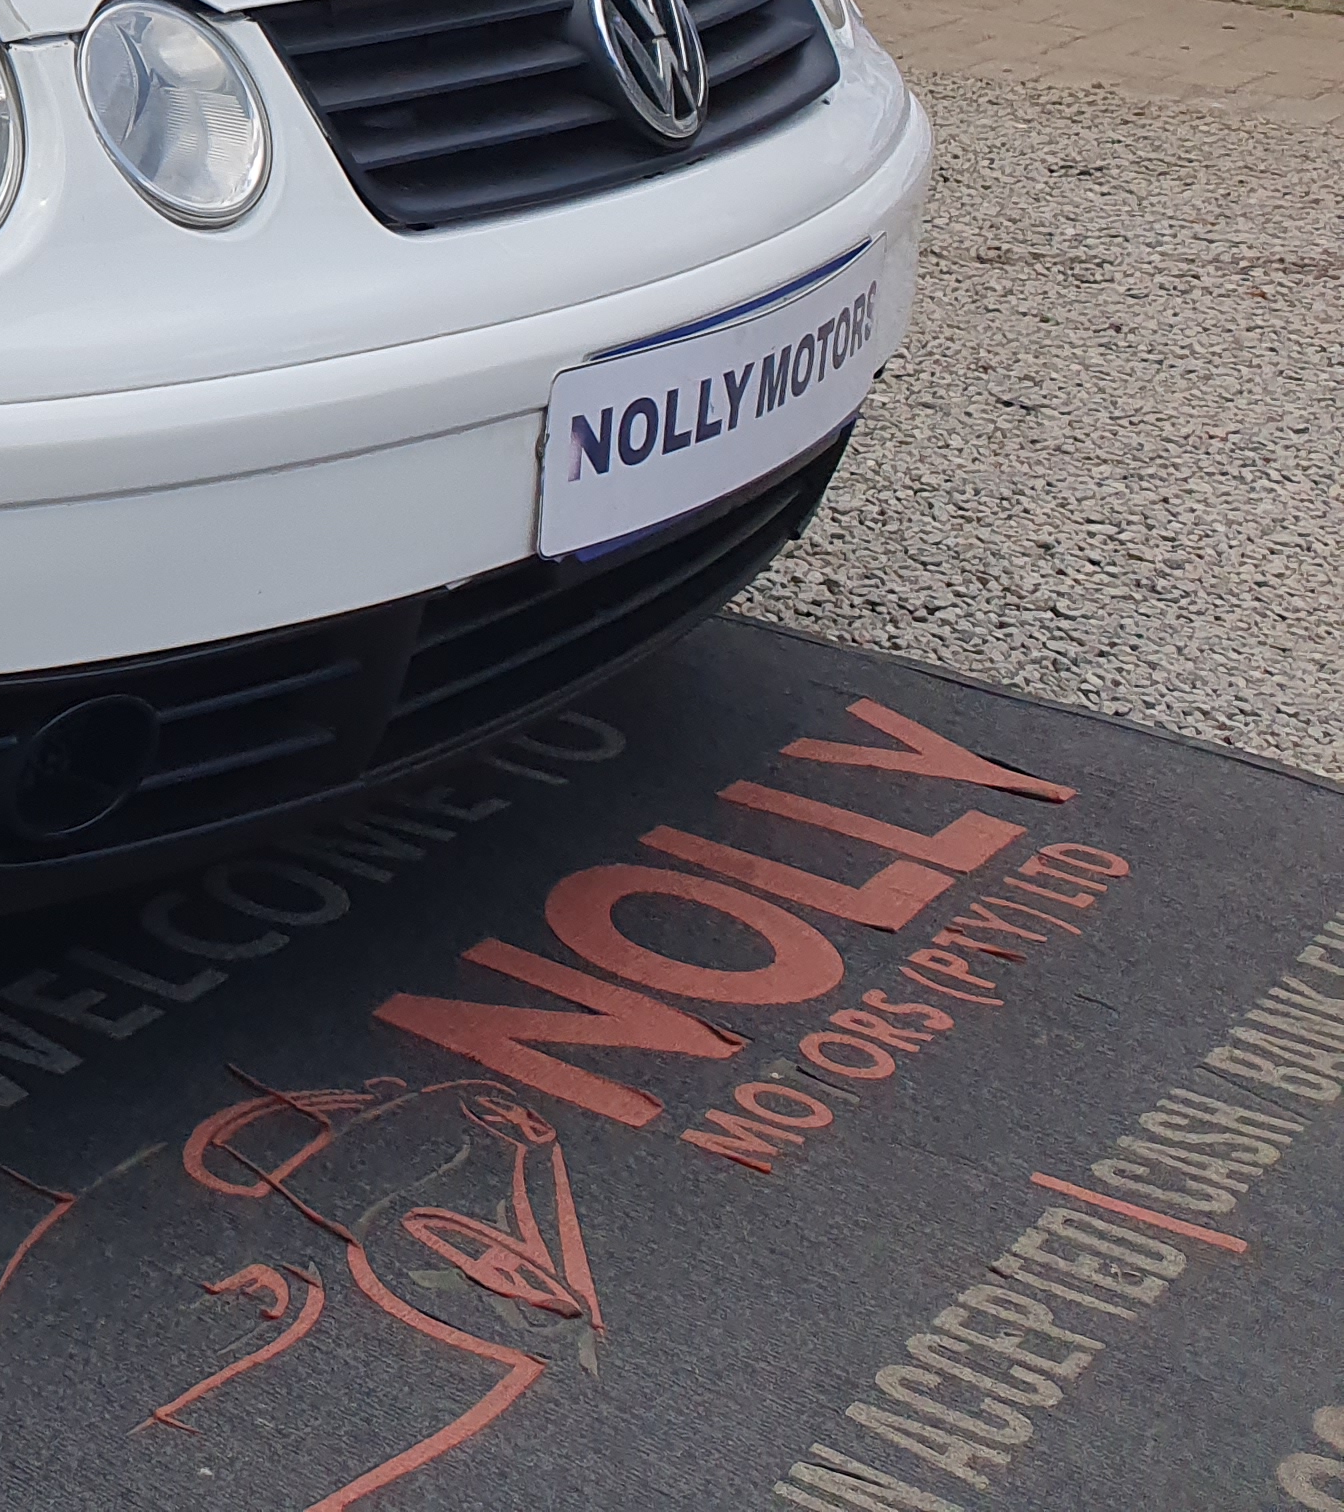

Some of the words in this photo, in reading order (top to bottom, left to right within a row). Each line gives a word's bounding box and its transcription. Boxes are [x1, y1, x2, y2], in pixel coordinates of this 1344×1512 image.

[567, 362, 755, 482] NOLLY
[755, 280, 877, 419] MOTORS
[372, 699, 1076, 1128] NOLLY
[1004, 842, 1129, 908] LTD
[845, 1207, 1188, 1490] ACCEPTED
